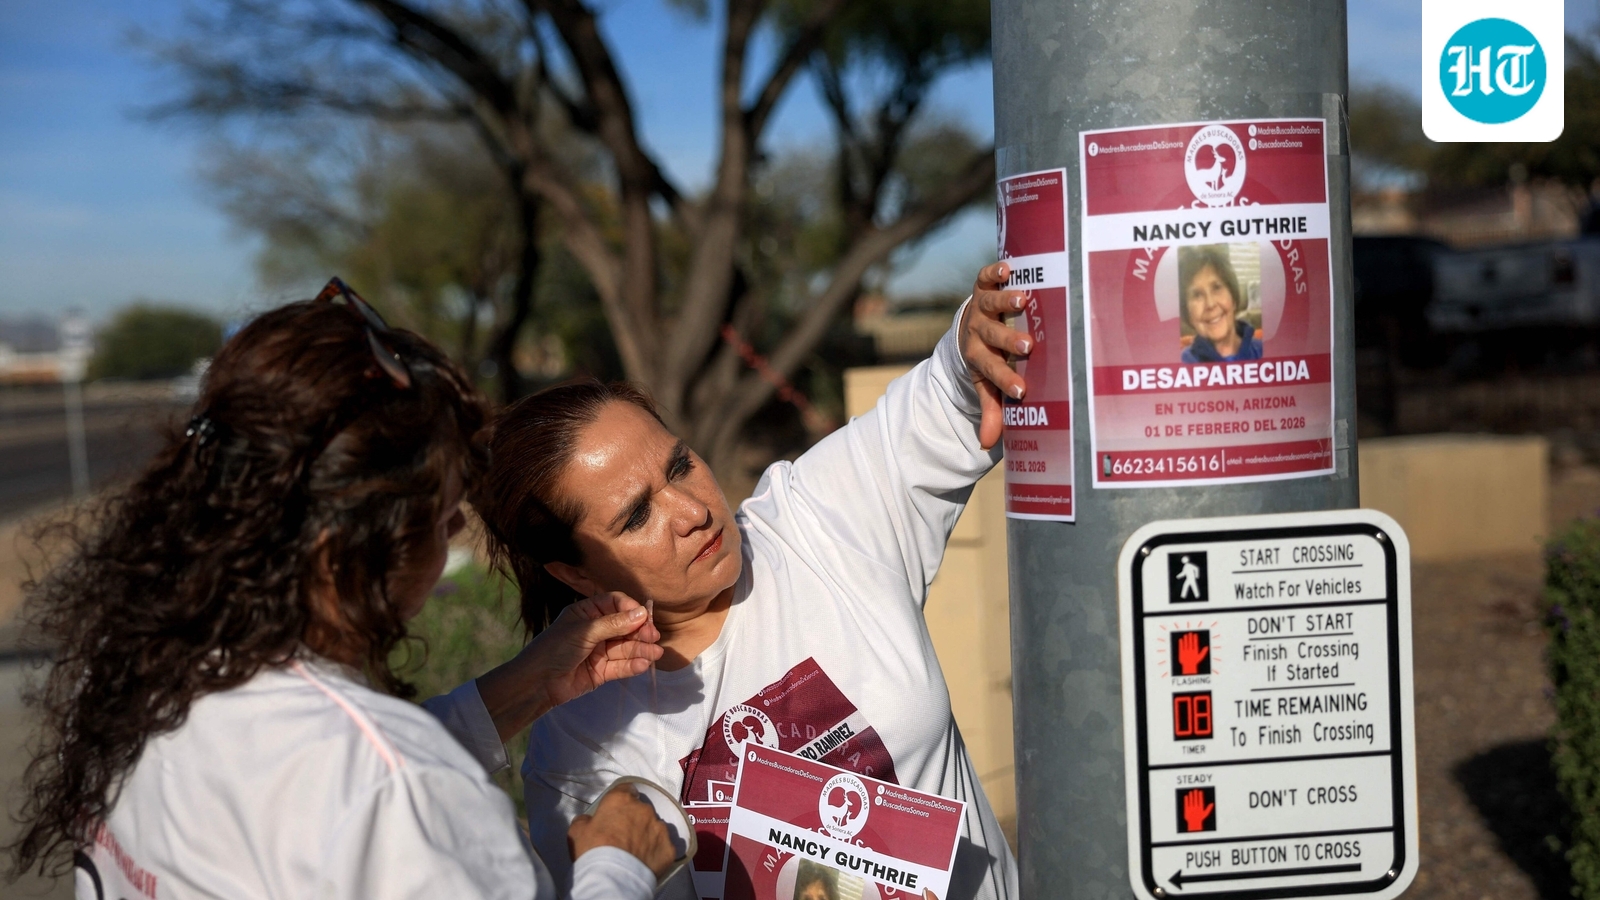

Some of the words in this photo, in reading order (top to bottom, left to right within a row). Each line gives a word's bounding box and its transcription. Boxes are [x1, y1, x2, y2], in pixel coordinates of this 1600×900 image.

[1257, 126, 1320, 135] MadresBuscadorasDeSonora
[1099, 141, 1183, 154] MadresBuscadorasDeSonora
[1187, 134, 1206, 163] MADRES
[1207, 129, 1244, 161] BUSCADORAS
[1257, 140, 1302, 149] BuscadoraSonora
[1133, 222, 1211, 241] NANCY
[1221, 217, 1307, 235] GUTHRIE
[1123, 360, 1309, 390] DESAPARECIDA
[1155, 403, 1173, 415] EN
[1179, 400, 1239, 414] TUCSON,
[1243, 396, 1296, 410] ARIZONA
[1145, 425, 1160, 437] 01
[1165, 424, 1183, 436] DE
[1188, 420, 1250, 435] FEBRERO
[1255, 419, 1277, 432] DEL
[1280, 417, 1306, 429] 2026
[1028, 461, 1046, 472] 2026
[1113, 455, 1219, 474] 6623415616
[1240, 547, 1281, 566] START
[1292, 544, 1354, 562] CROSSING
[1234, 580, 1274, 599] Watch
[1279, 580, 1299, 597] For
[1306, 577, 1361, 595] Vehicles
[1248, 615, 1296, 634] DON'T
[1306, 612, 1353, 631] START
[1243, 643, 1288, 662] Finish
[1298, 641, 1359, 660] Crossing
[1172, 677, 1211, 686] FLASHING
[1267, 665, 1276, 681] If
[1286, 662, 1339, 680] Started
[729, 705, 769, 724] BUSCADORAS
[1174, 695, 1212, 737] 08
[1234, 700, 1272, 718] TIME
[1278, 693, 1368, 716] REMAINING
[725, 715, 734, 745] MADRES
[813, 722, 855, 755] RAMÍREZ
[1230, 727, 1246, 747] To
[1259, 726, 1302, 745] Finish
[1313, 721, 1374, 744] Crossing
[1182, 745, 1206, 754] TIMER
[757, 757, 823, 782] MadresBuscadorasDeSonora
[1177, 774, 1212, 785] STEADY
[822, 778, 842, 797] MADRES
[843, 778, 868, 810] BUSCADORAS
[885, 789, 957, 813] MadresBuscadorasDeSonora
[1248, 789, 1298, 809] DON'T
[1307, 786, 1358, 804] CROSS
[883, 799, 929, 818] BuscadoraSonora
[769, 828, 831, 859] NANCY
[835, 852, 918, 889] GUTHRIE
[1186, 851, 1221, 868] PUSH
[1231, 848, 1286, 866] BUTTON
[1295, 844, 1310, 861] TO
[1315, 841, 1361, 859] CROSS
